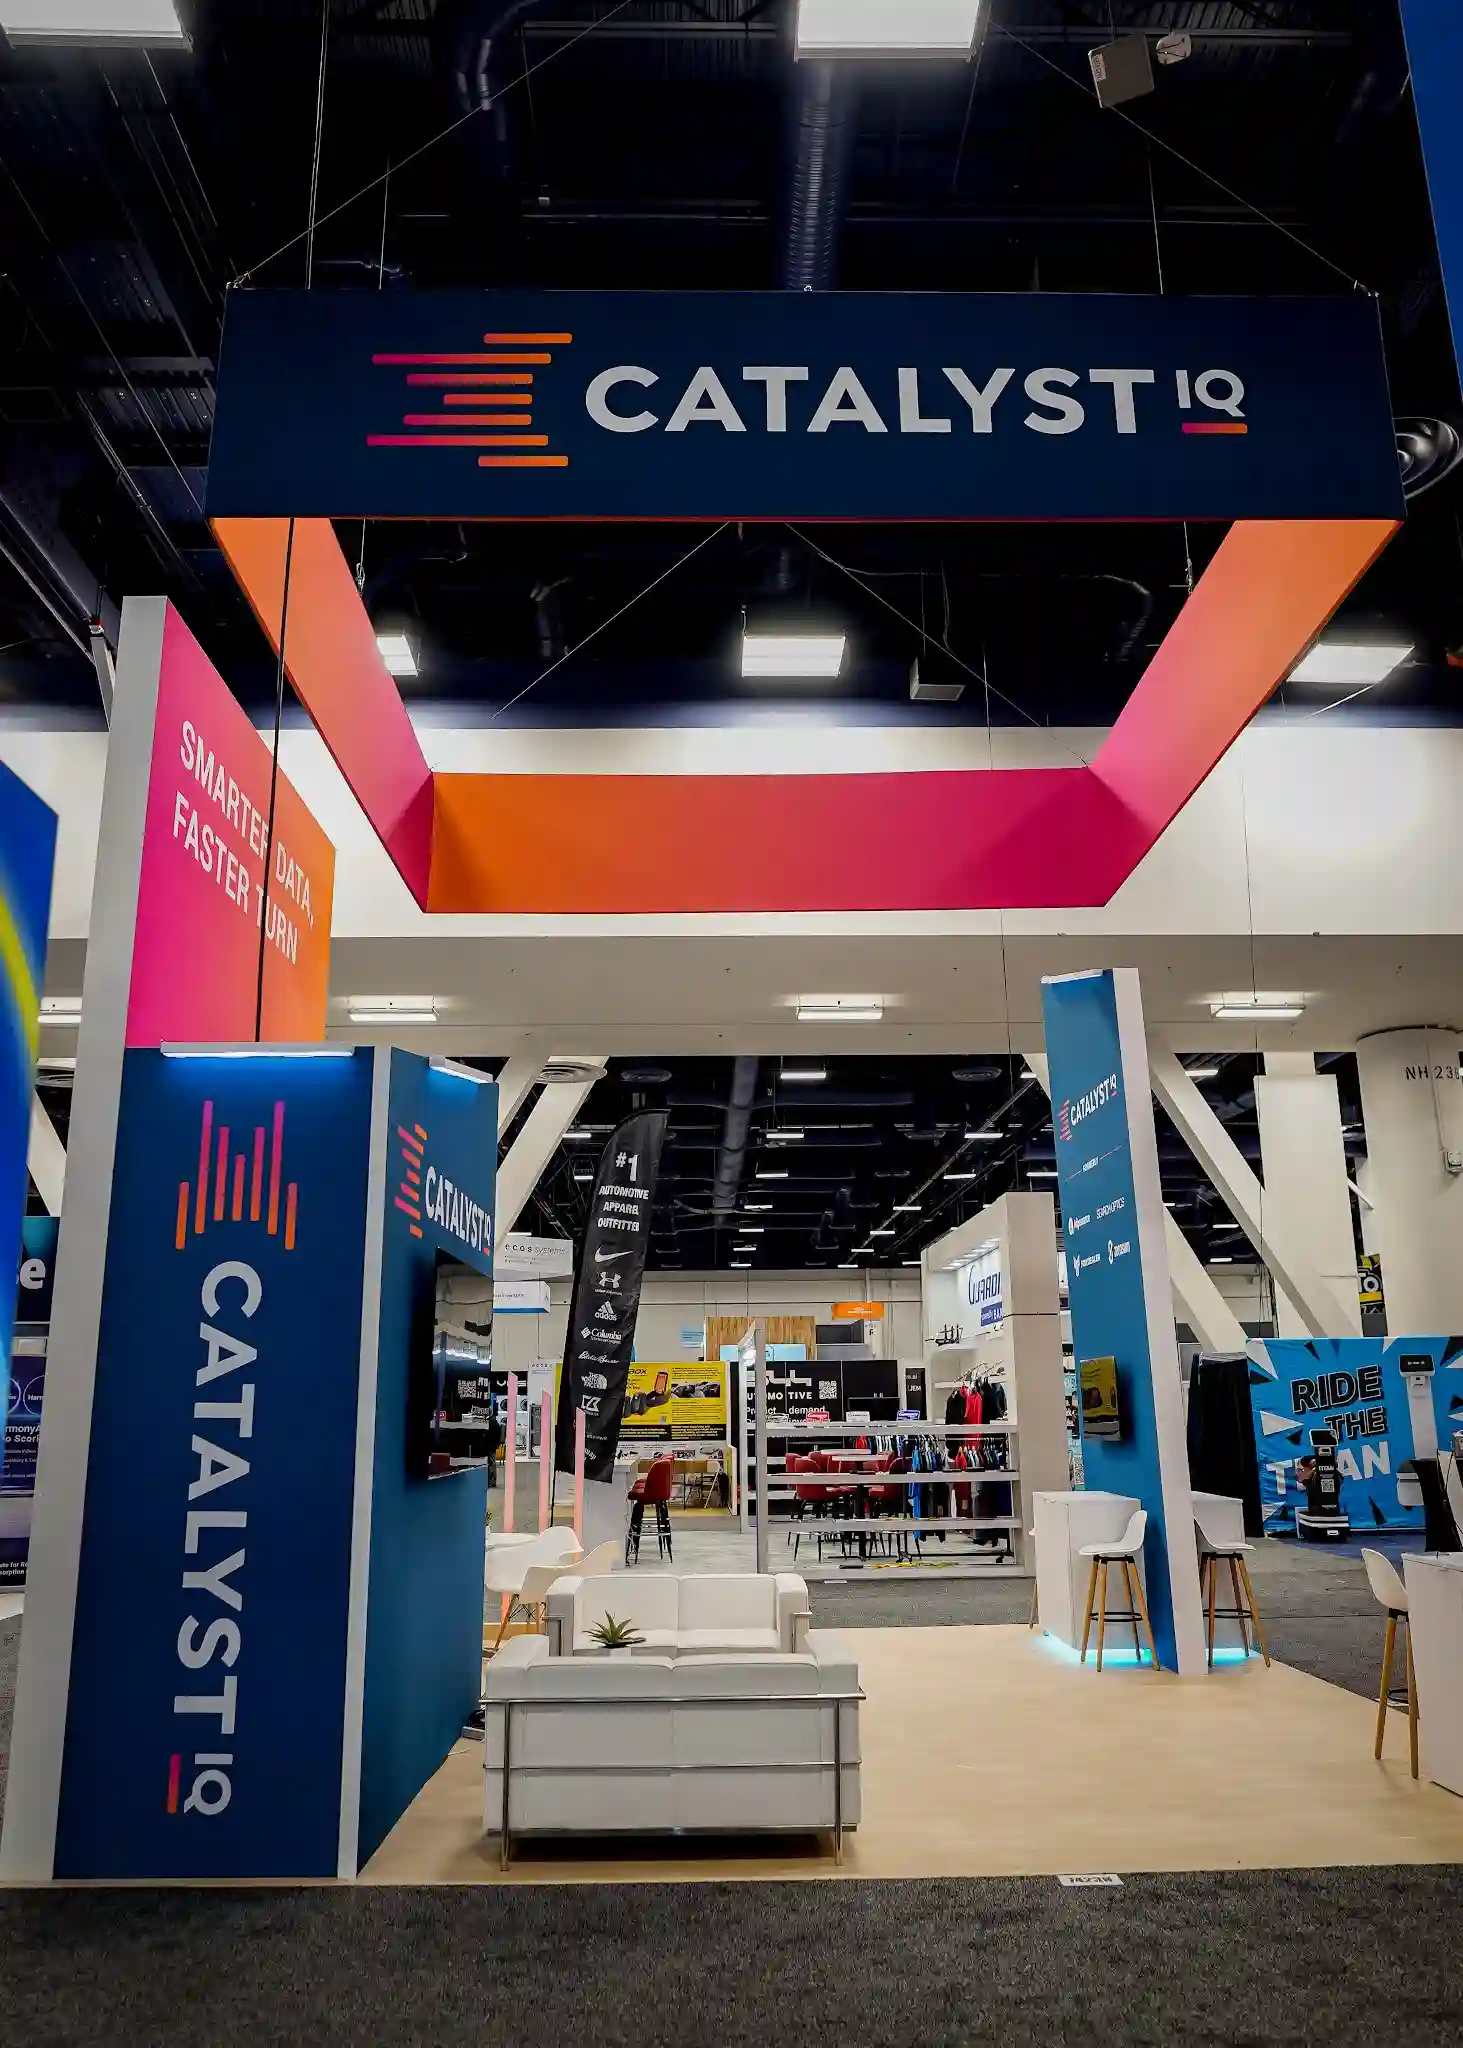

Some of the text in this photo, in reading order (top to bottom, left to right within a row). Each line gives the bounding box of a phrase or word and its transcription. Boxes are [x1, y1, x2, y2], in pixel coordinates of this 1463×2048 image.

[585, 366, 1247, 435] CATALYST IQ
[173, 791, 299, 965] FASTER TURN
[275, 841, 314, 931] DATA,
[1405, 1064, 1429, 1080] NH
[1070, 1079, 1110, 1126] CATALYST
[615, 1151, 639, 1182] #1
[425, 1166, 484, 1252] CATALYST
[598, 1185, 650, 1200] AUTOMOTIVE
[603, 1201, 640, 1216] APPAREL
[591, 1328, 621, 1341] Columbia
[1290, 1364, 1383, 1414] RIDE
[788, 1405, 826, 1416] demand
[1323, 1405, 1387, 1443] THE
[173, 1261, 263, 1816] CATALYST IQ
